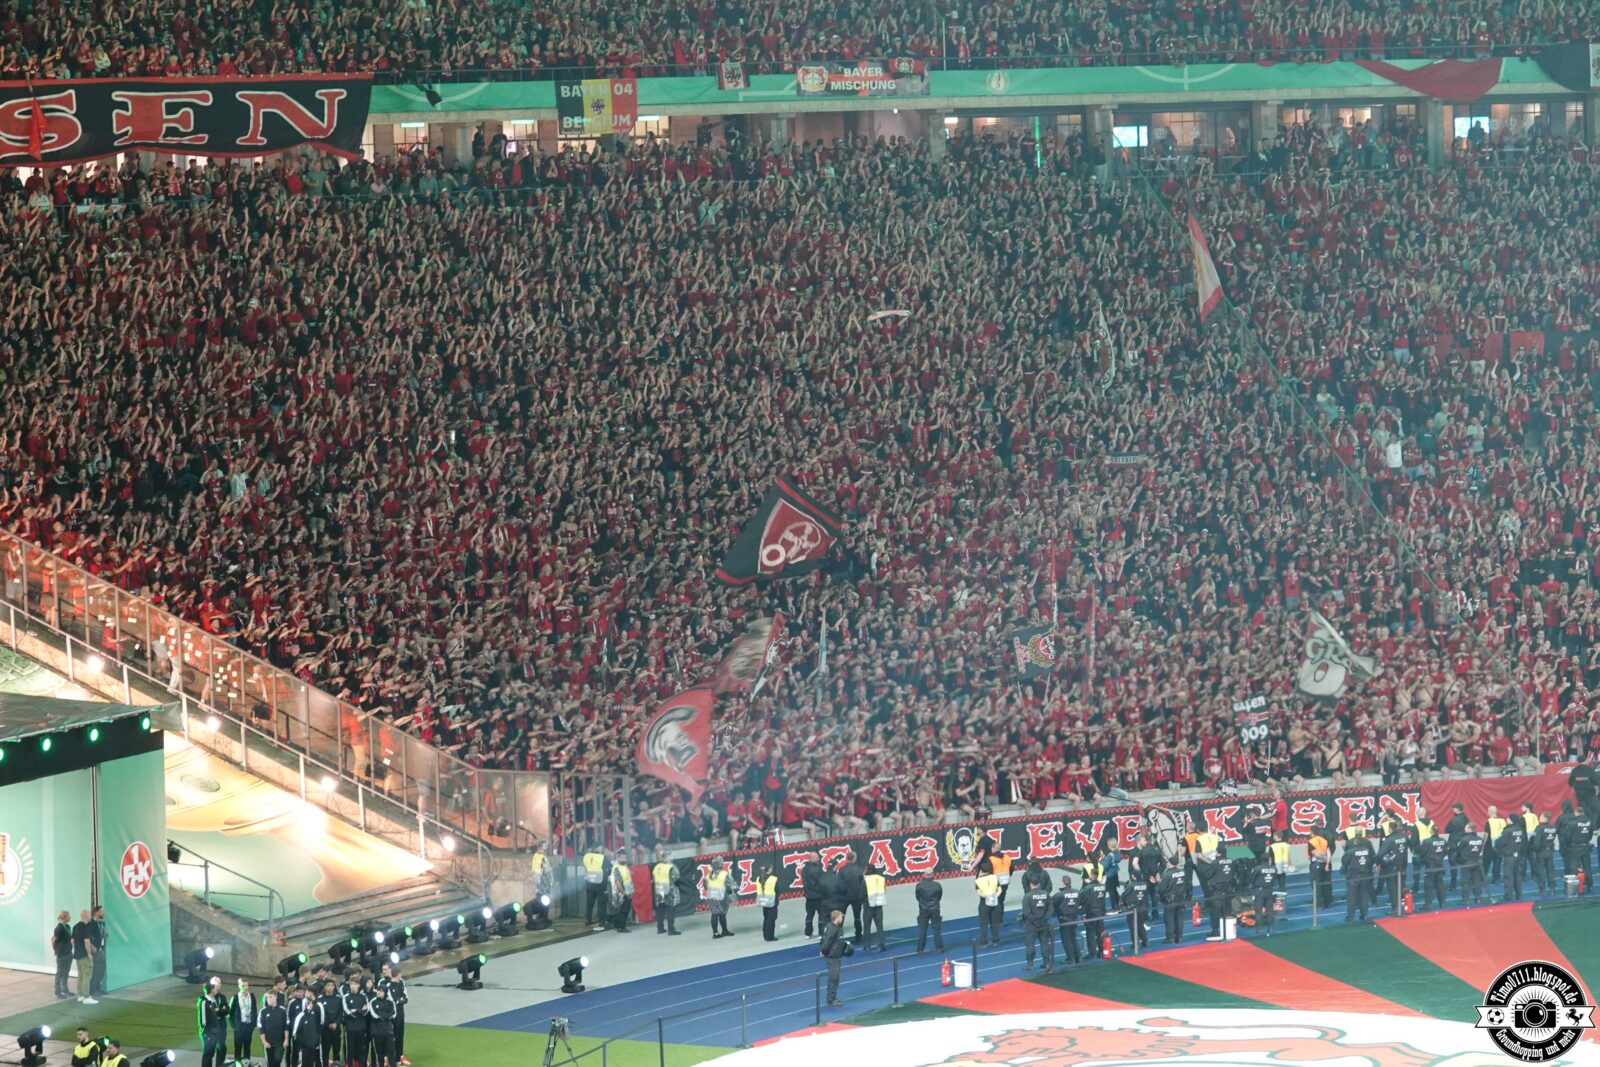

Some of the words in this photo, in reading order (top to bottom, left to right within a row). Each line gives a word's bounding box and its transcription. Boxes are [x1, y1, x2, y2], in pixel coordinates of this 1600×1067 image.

[842, 66, 883, 77] BAYER
[560, 84, 608, 98] BAYER
[613, 83, 633, 96] 04
[830, 80, 897, 91] MISCHUNG
